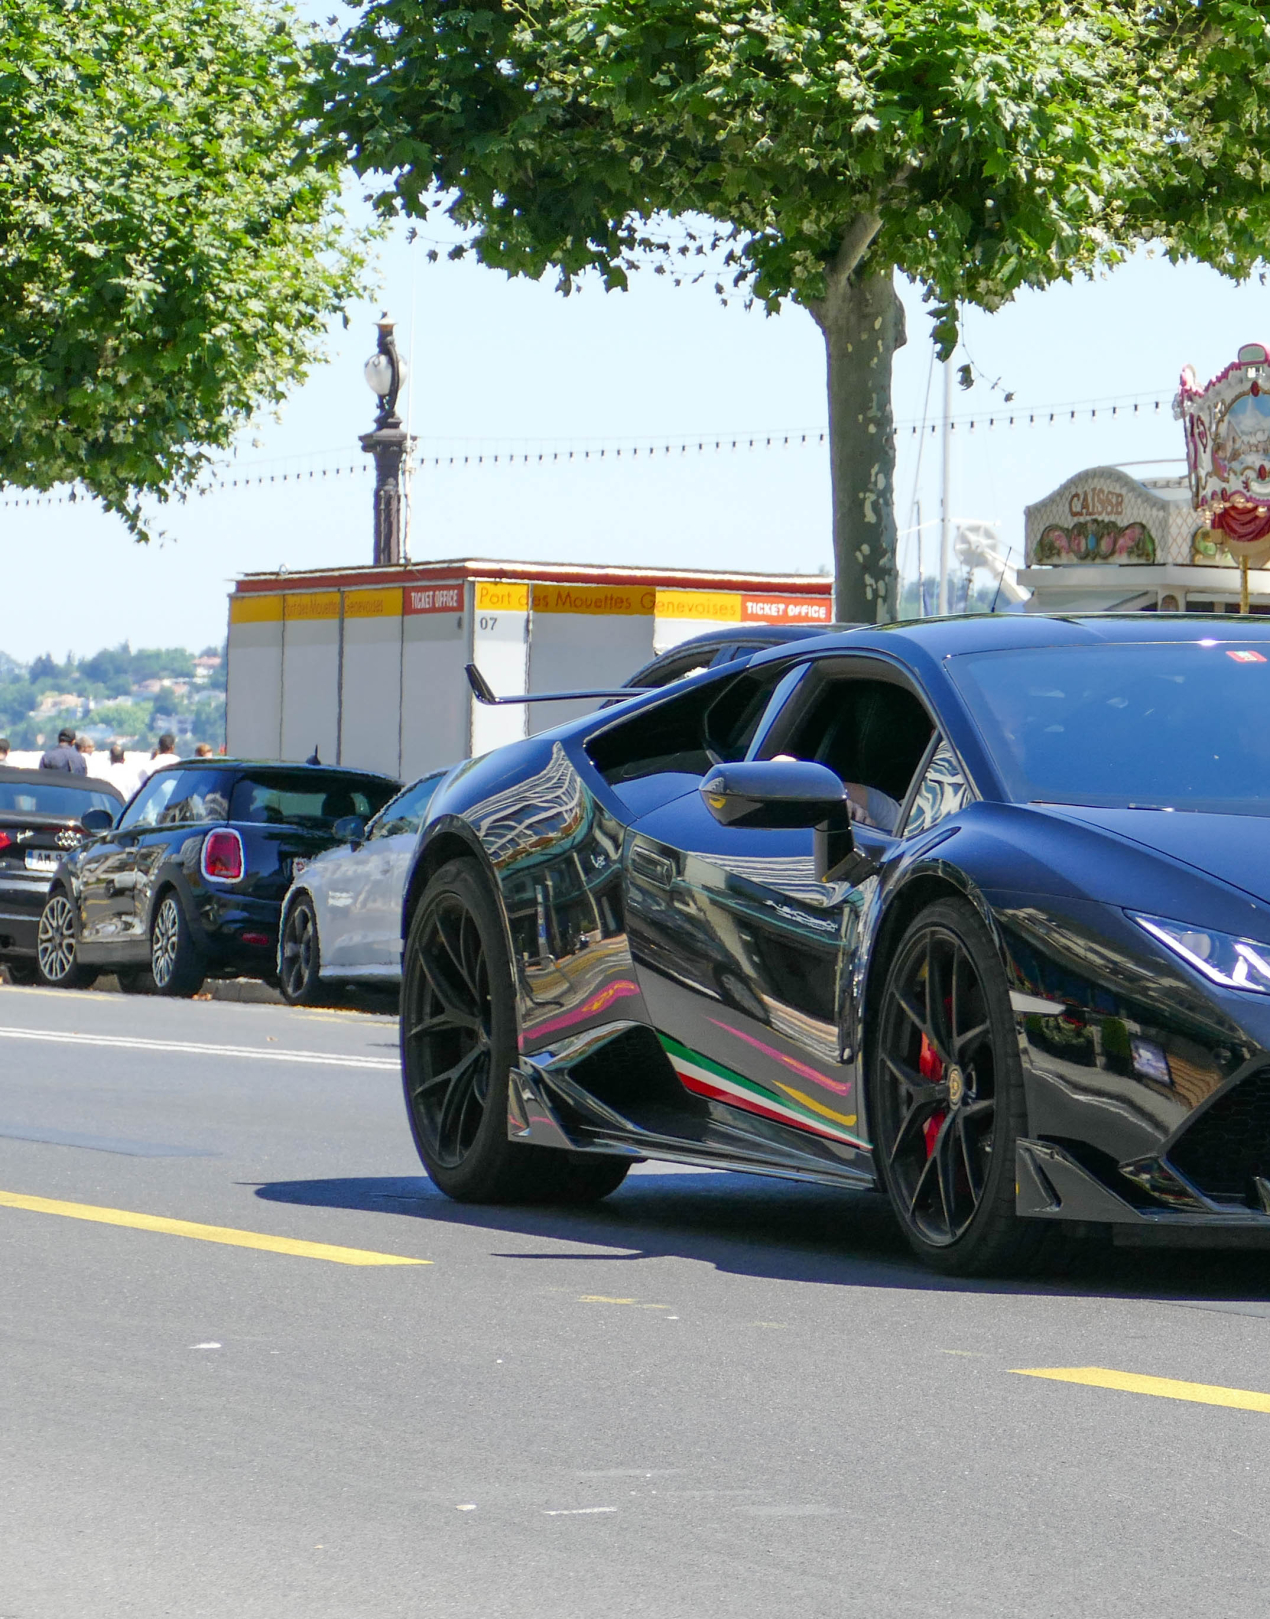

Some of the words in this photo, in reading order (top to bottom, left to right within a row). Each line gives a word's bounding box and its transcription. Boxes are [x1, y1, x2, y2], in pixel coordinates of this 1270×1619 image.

[1069, 487, 1125, 518] CAISSE
[411, 591, 434, 609] TICKET
[435, 589, 458, 608] OFFICE
[480, 586, 511, 605] Port
[555, 590, 632, 610] Mouettes
[640, 591, 736, 617] Genevoises
[746, 601, 785, 616] TICKET
[787, 603, 827, 619] OFFICE
[479, 617, 498, 631] 07
